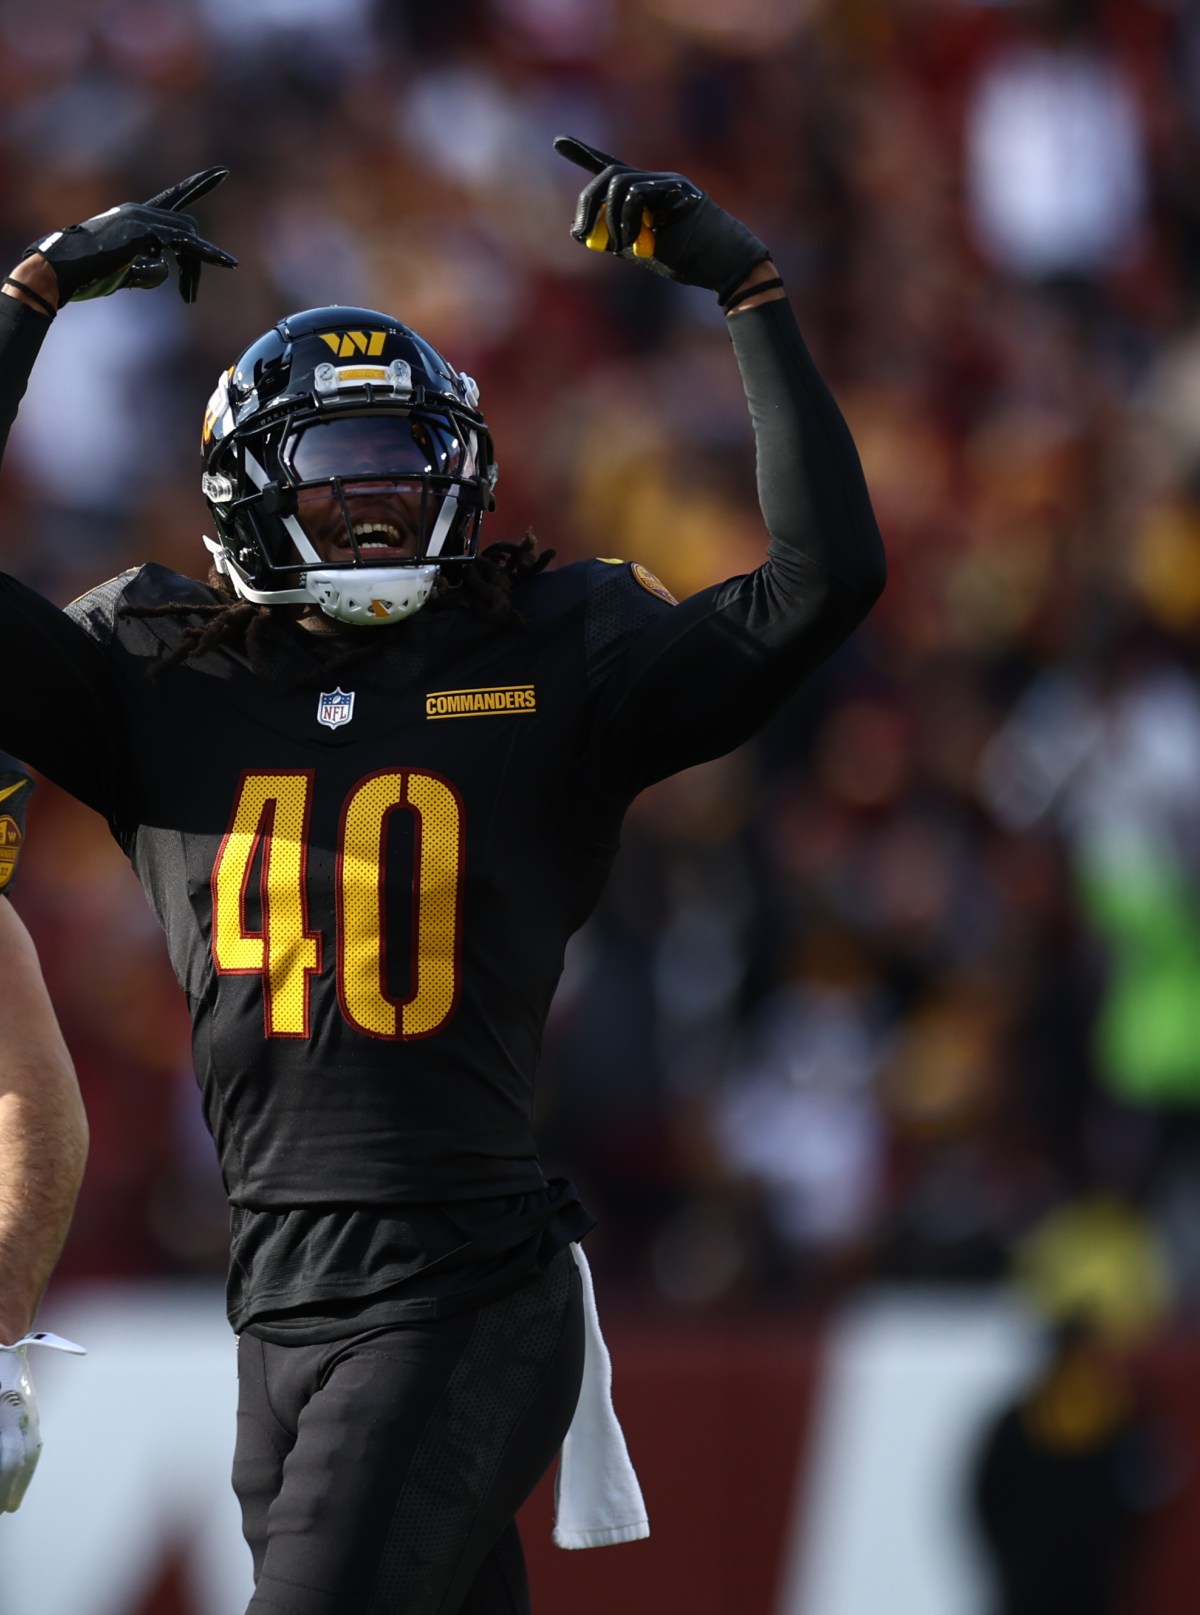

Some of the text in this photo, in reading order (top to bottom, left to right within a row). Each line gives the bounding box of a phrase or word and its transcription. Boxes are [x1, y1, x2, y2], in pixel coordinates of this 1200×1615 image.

[323, 705, 347, 721] NFL
[426, 690, 536, 715] COMMANDERS
[210, 766, 466, 1042] 40
